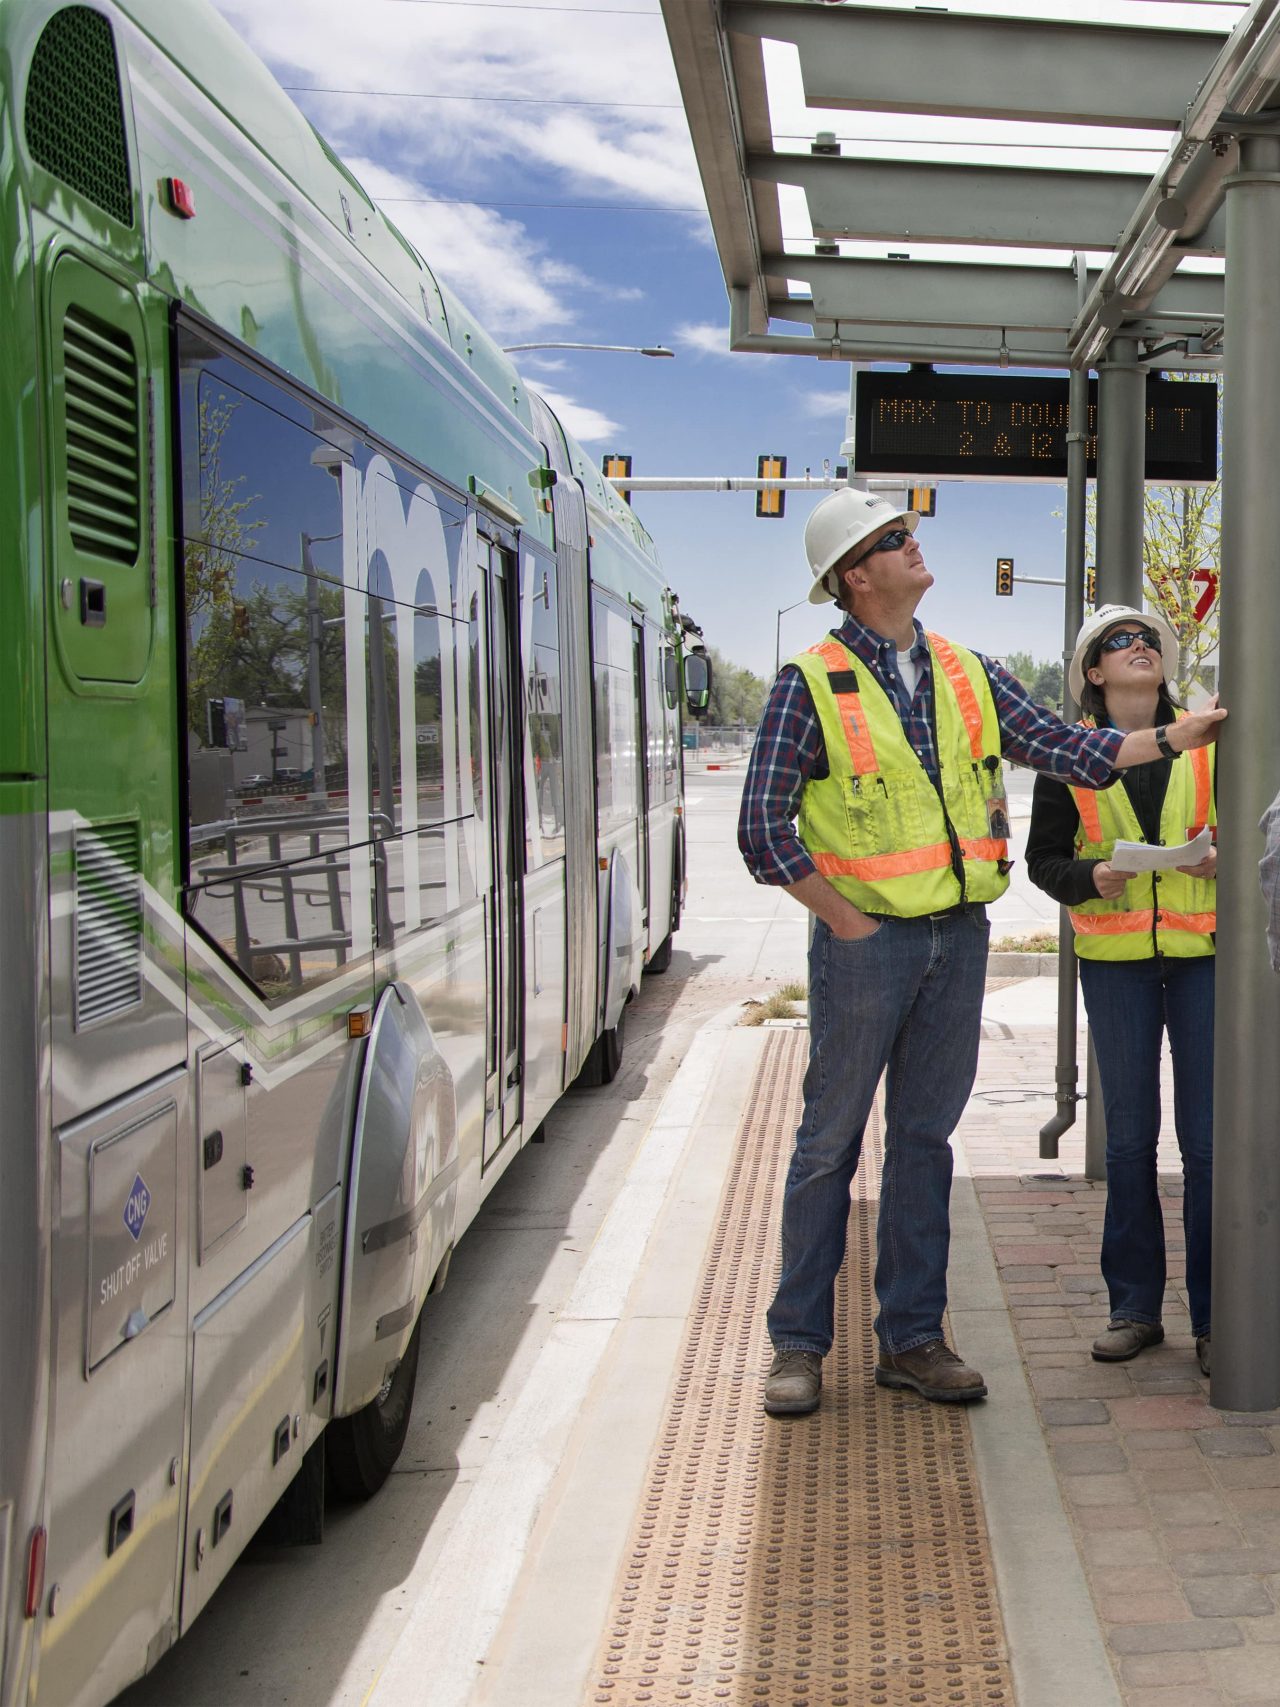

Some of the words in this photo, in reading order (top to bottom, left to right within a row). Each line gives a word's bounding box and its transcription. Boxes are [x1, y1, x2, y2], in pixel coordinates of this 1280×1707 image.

[880, 398, 936, 424] MAX
[956, 400, 991, 425] TO
[959, 431, 973, 456] 2
[992, 432, 1011, 456] &
[1031, 433, 1052, 457] 12
[128, 1189, 147, 1224] CNG
[101, 1266, 125, 1305] SHUT
[125, 1252, 141, 1286] OFF
[144, 1233, 168, 1270] VALVE
